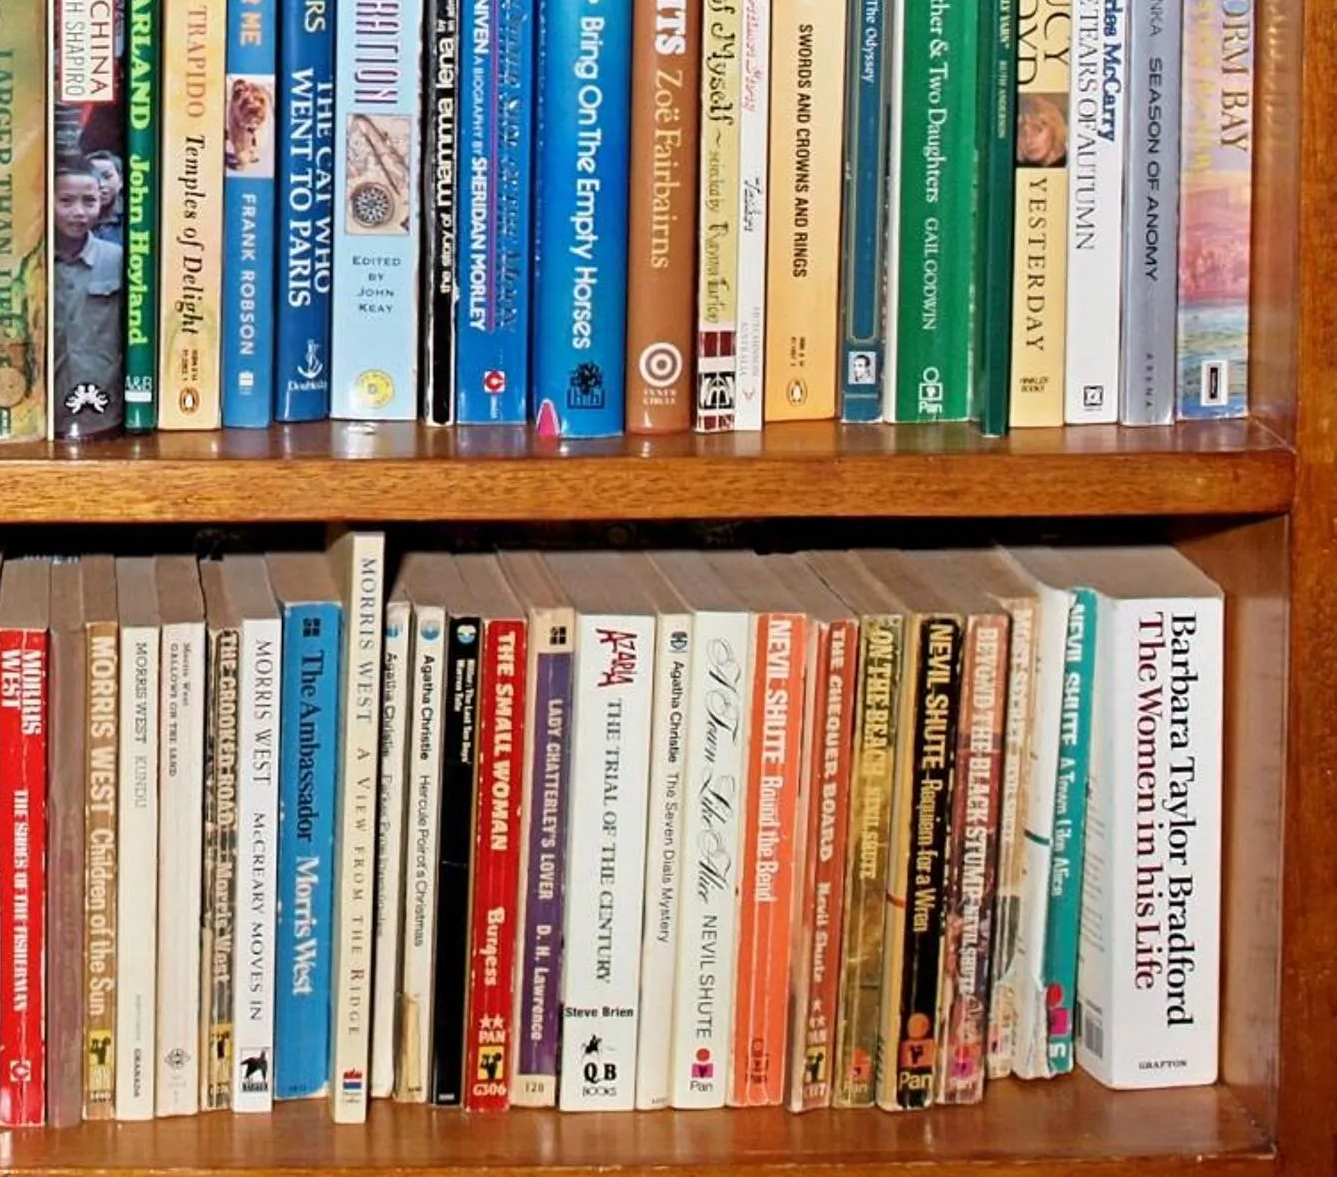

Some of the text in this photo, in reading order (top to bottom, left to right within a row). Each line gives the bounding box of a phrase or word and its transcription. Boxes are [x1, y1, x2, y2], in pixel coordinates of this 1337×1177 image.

[654, 69, 683, 122] Zoë
[861, 0, 879, 82] The Odyssey
[1222, 91, 1248, 152] BAY
[650, 129, 682, 268] Fairbairns
[240, 193, 257, 355] FRANK ROBSON
[360, 288, 394, 296] JOHN
[922, 217, 939, 329] GAIL GODWIN
[1025, 178, 1047, 351] YESTERDAY
[411, 775, 431, 946] Hercule Poirot's Christmas
[913, 779, 942, 932] Requiem for a Wren
[1135, 612, 1164, 989] The Women in his Life
[1163, 615, 1198, 1027] Barbara Taylor Bradford
[292, 855, 318, 995] Morris West
[480, 909, 503, 985] Burgess
[696, 915, 718, 1038] NEVIL SHUTE
[565, 1007, 634, 1018] Steve Brien
